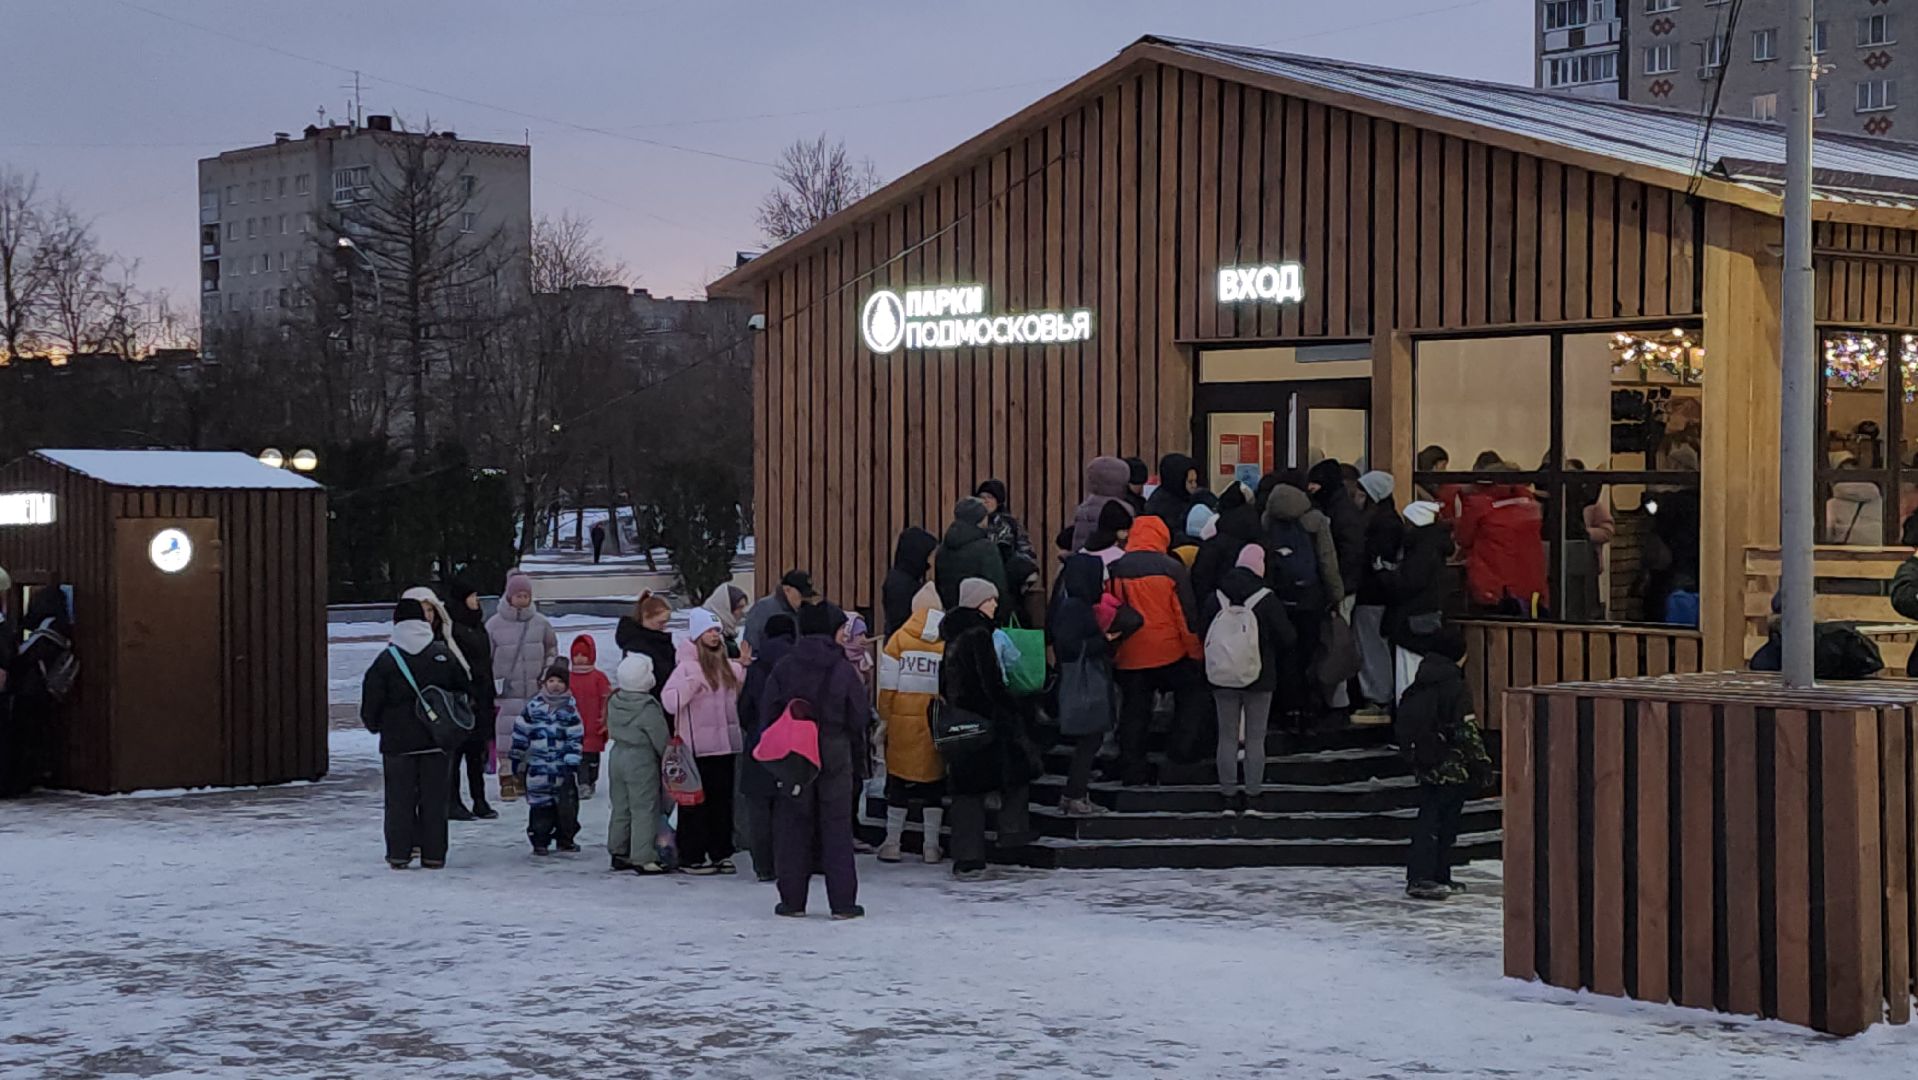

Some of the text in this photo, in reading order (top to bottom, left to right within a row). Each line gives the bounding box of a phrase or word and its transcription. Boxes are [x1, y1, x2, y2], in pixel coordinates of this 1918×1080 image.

[905, 286, 983, 317] ПАРКИ
[1218, 264, 1303, 303] ВХОД
[905, 311, 1091, 349] ПОДМОСКОВЬЯ
